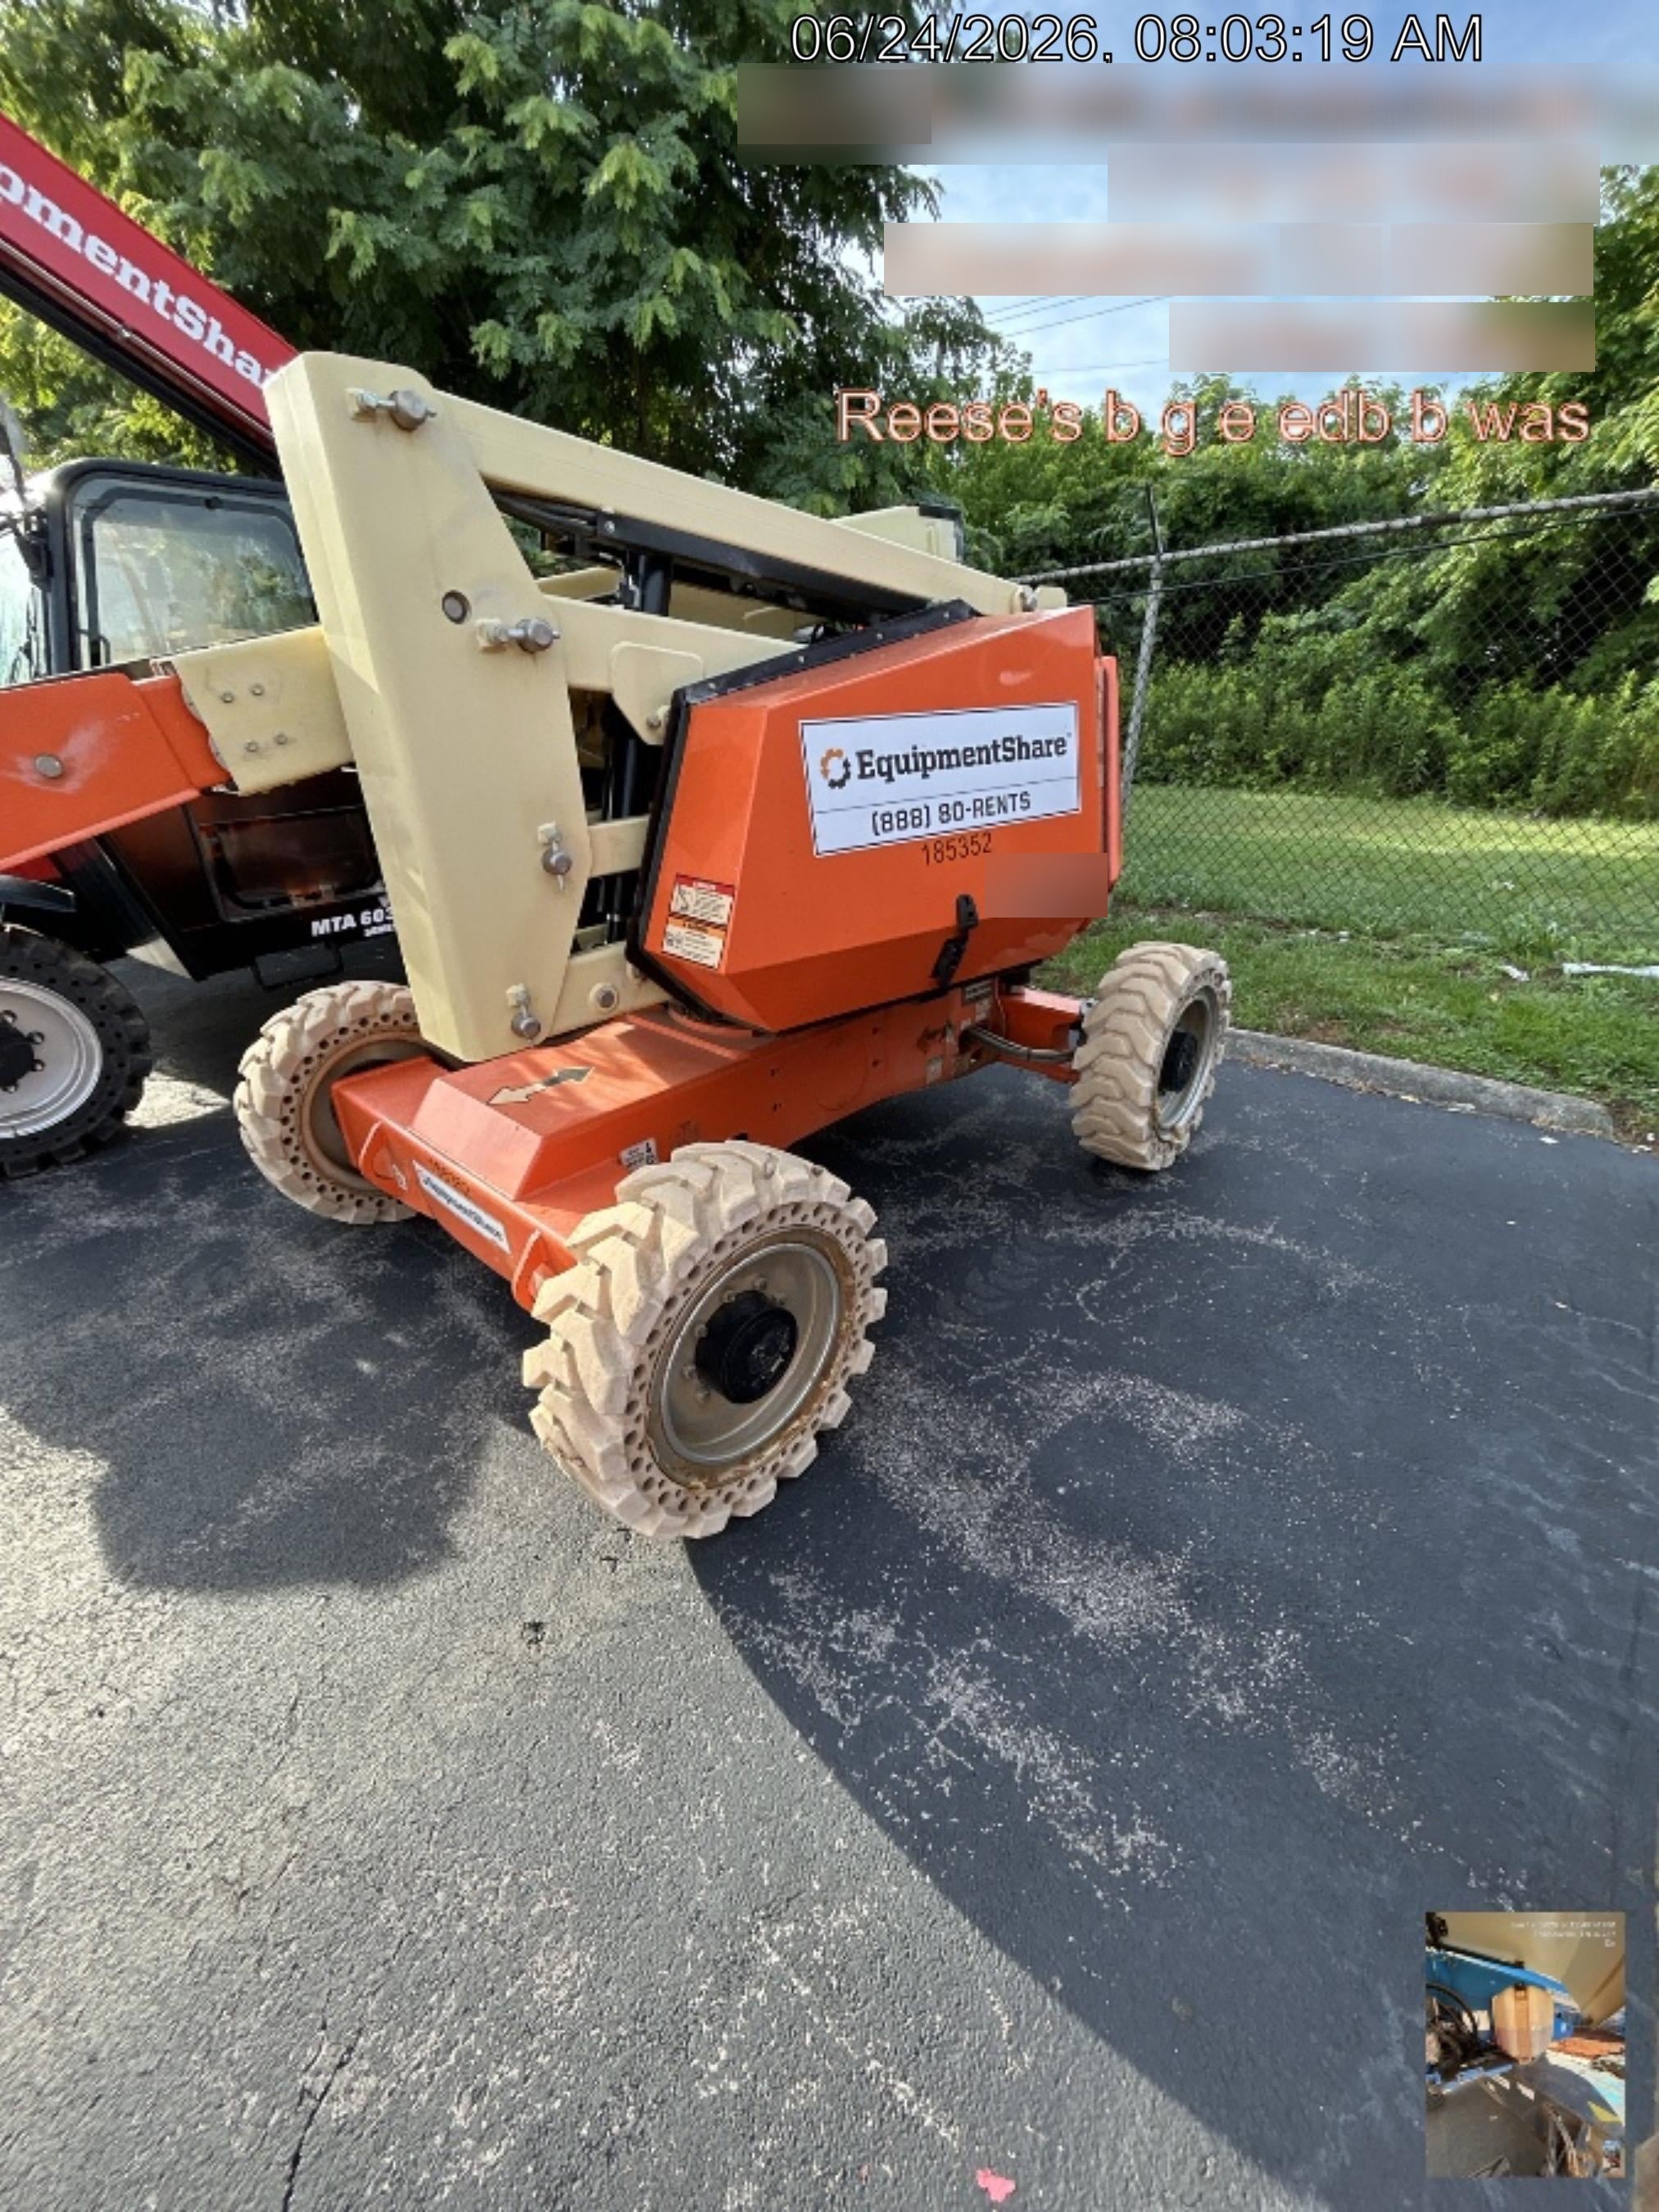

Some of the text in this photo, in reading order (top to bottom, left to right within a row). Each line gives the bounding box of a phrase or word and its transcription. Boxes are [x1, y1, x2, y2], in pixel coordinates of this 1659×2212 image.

[0, 162, 270, 388] mentSha
[855, 734, 1067, 784] EquipmentShare
[872, 791, 1031, 836] (888) 80-RENTS
[921, 831, 992, 866] 185352
[310, 913, 357, 938] MTA
